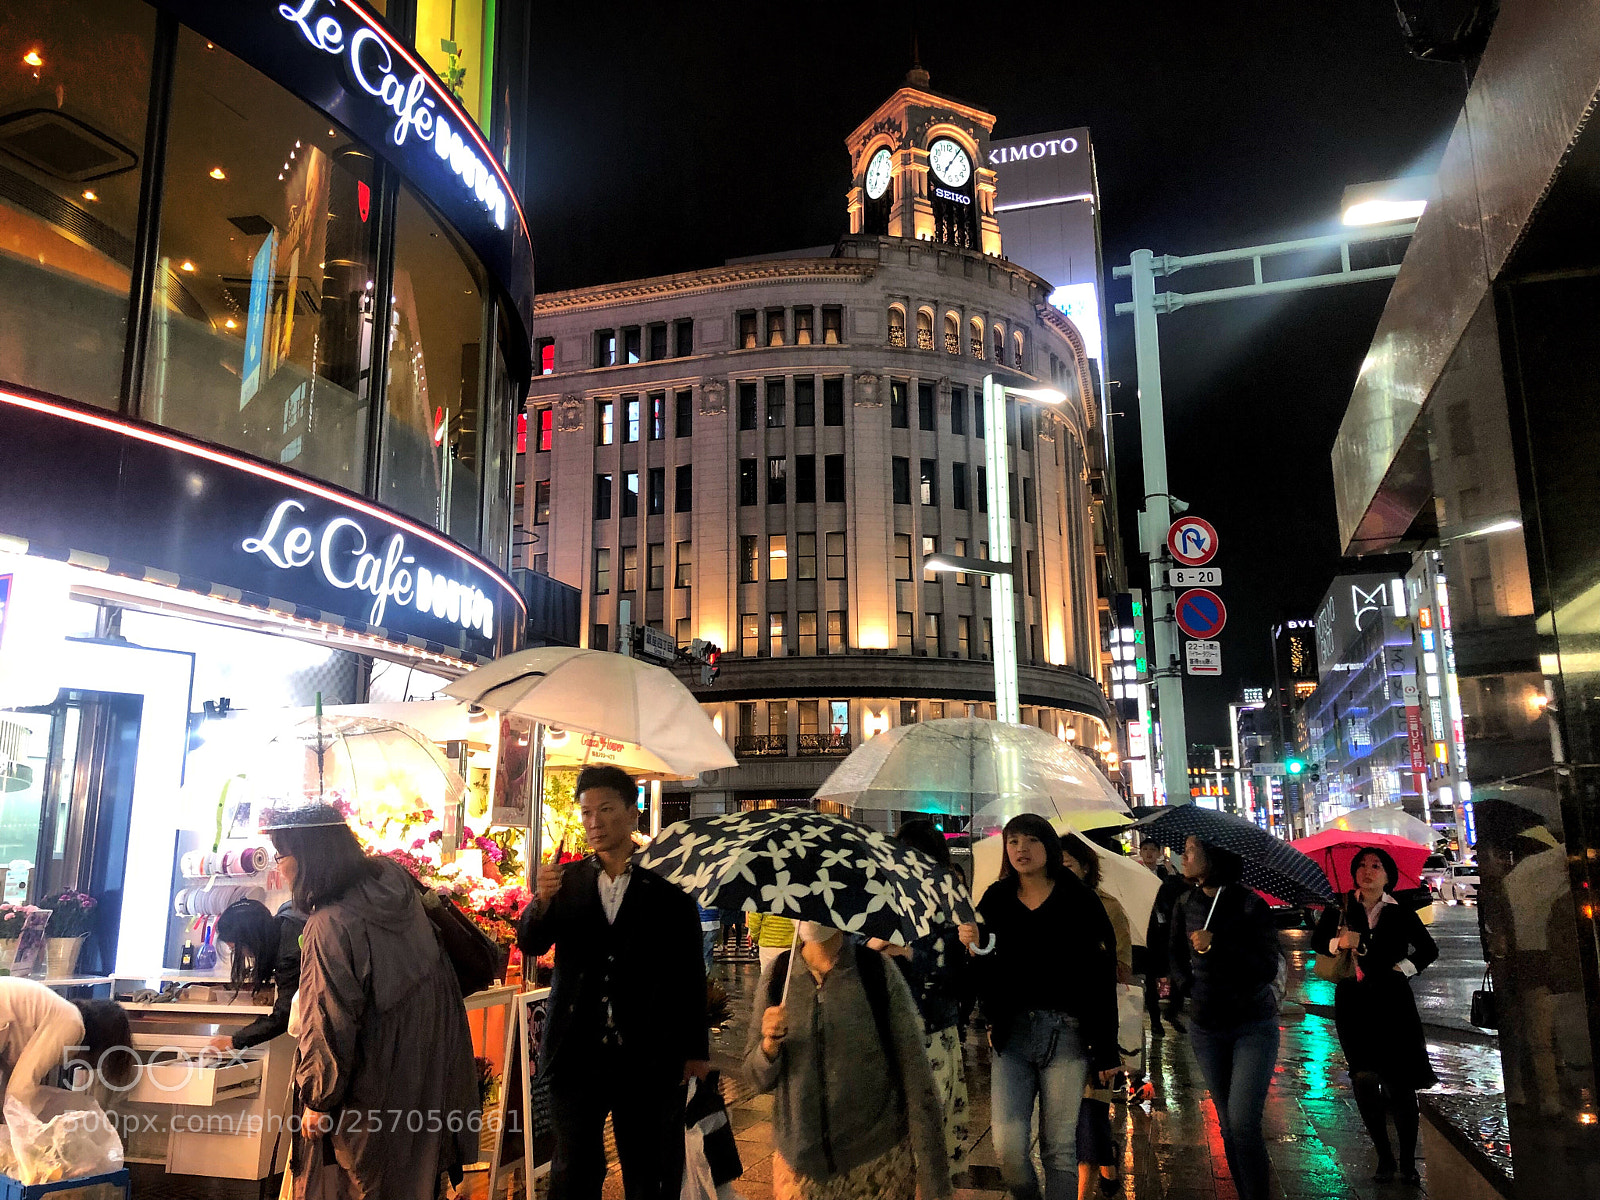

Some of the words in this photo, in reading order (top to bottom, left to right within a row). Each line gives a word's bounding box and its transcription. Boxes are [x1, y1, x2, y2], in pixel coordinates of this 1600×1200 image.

[278, 0, 344, 54] Le
[935, 188, 970, 205] SEIKO
[242, 500, 314, 568] Le
